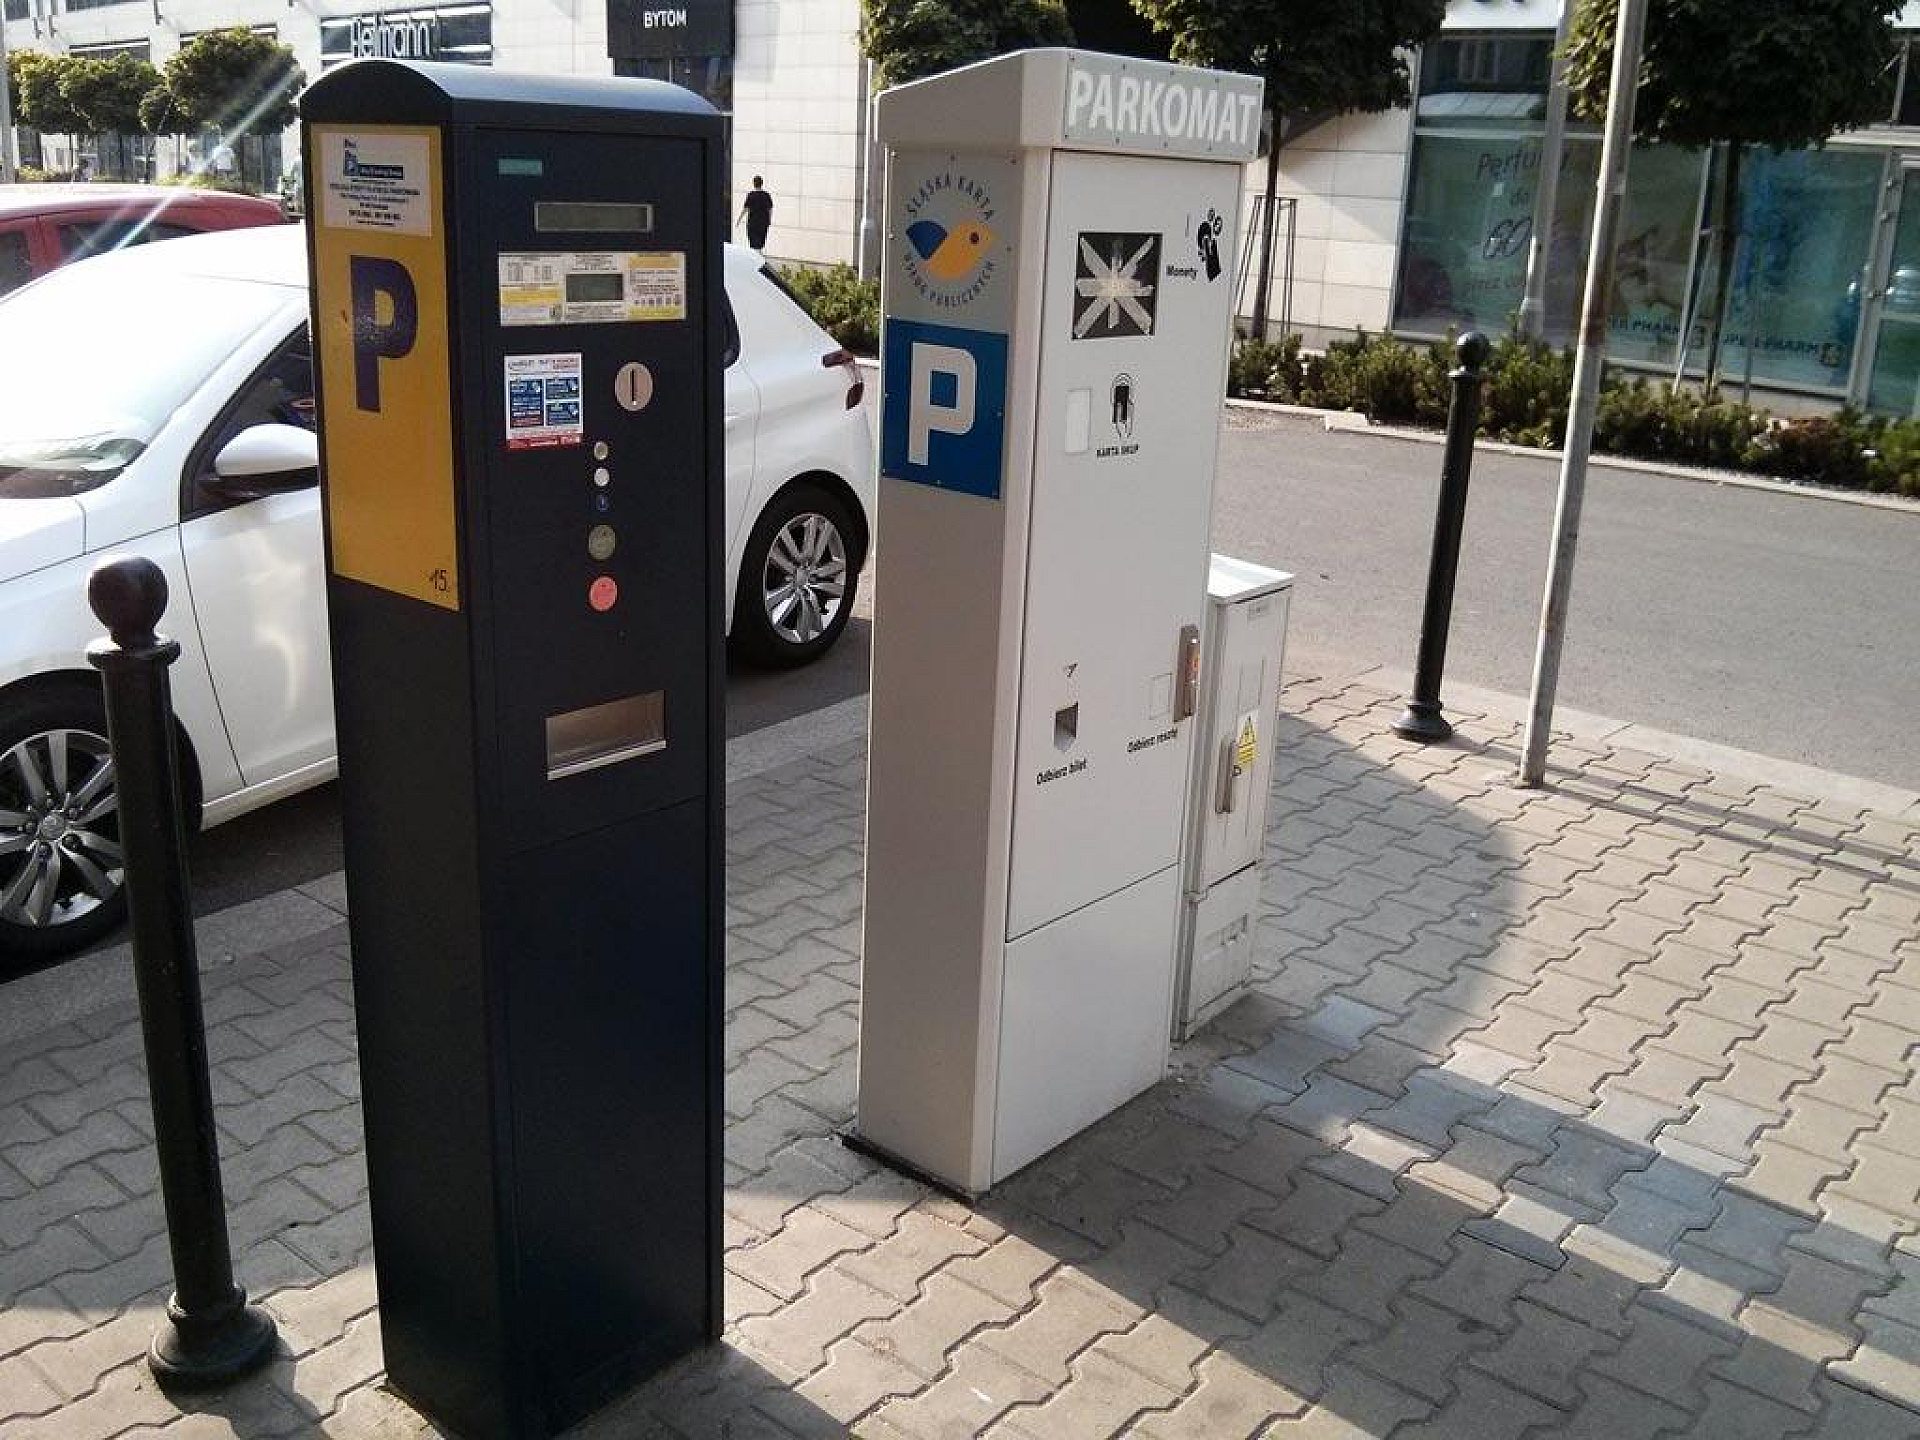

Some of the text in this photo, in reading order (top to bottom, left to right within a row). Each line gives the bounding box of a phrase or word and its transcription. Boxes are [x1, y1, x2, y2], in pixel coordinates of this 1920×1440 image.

[643, 8, 688, 28] BYTOM
[1068, 69, 1260, 145] PARKOMAT
[1166, 264, 1198, 281] Monety
[351, 255, 419, 413] P
[908, 341, 978, 466] P
[1036, 757, 1087, 786] Odbierz bilet
